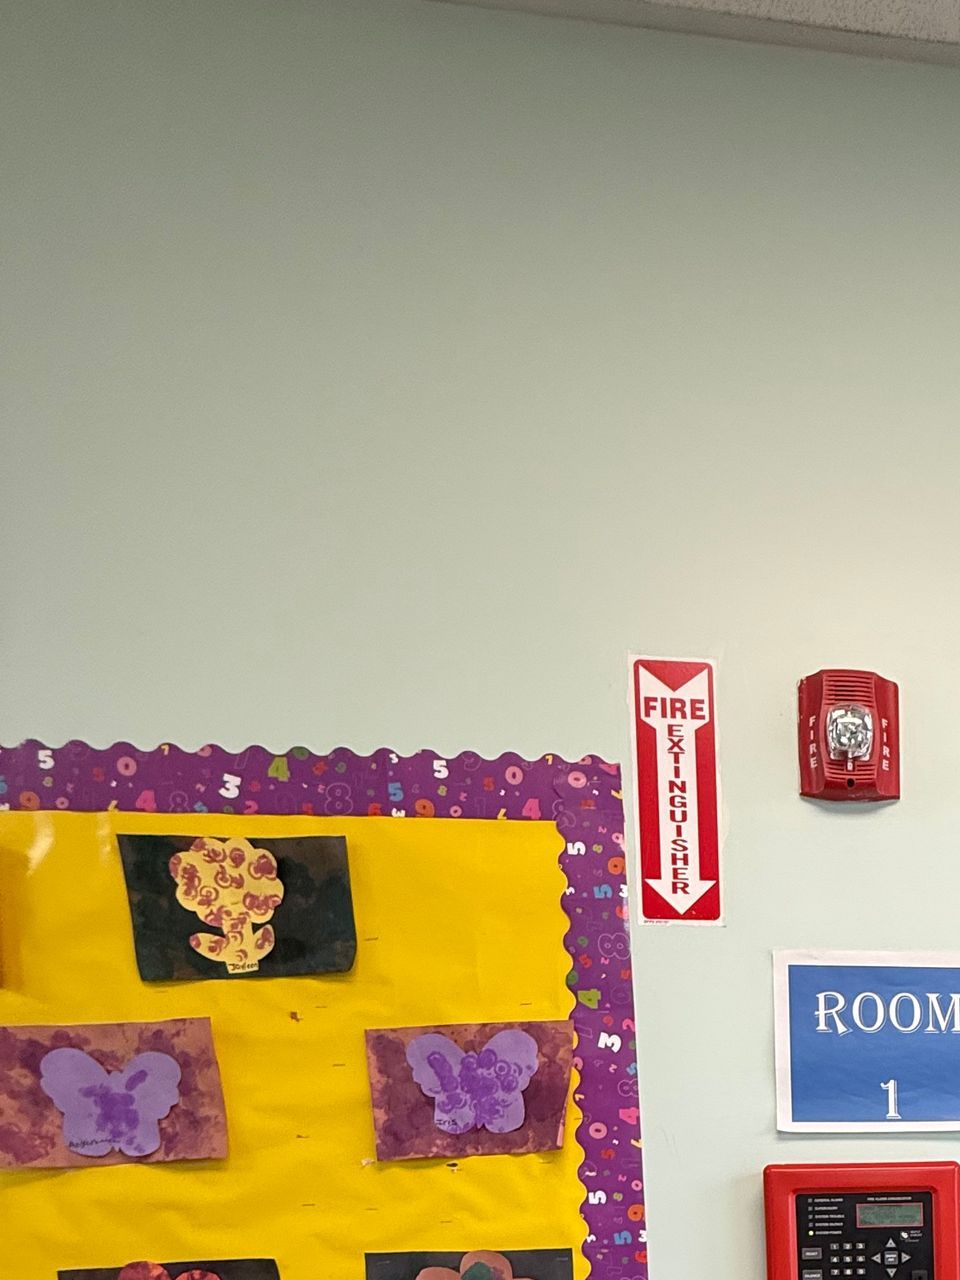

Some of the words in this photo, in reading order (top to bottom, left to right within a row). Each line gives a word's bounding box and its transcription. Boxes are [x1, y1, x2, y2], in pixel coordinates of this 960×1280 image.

[644, 697, 706, 720] FIRE
[809, 715, 818, 769] FIRE
[881, 718, 890, 771] FIRE
[38, 750, 54, 769] 5
[268, 756, 290, 782] 4
[389, 754, 398, 764] 3
[433, 760, 449, 778] 5
[218, 774, 242, 798] 3
[388, 782, 404, 801] 5
[136, 790, 157, 811] 4
[324, 782, 353, 816] 8
[522, 799, 542, 820] 4
[667, 724, 690, 894] EXTINGUISHER
[567, 841, 586, 856] 5
[593, 884, 612, 899] 5
[598, 1032, 622, 1053] 3
[880, 1079, 901, 1120] 1
[588, 1191, 606, 1204] 5
[614, 1230, 632, 1244] 5
